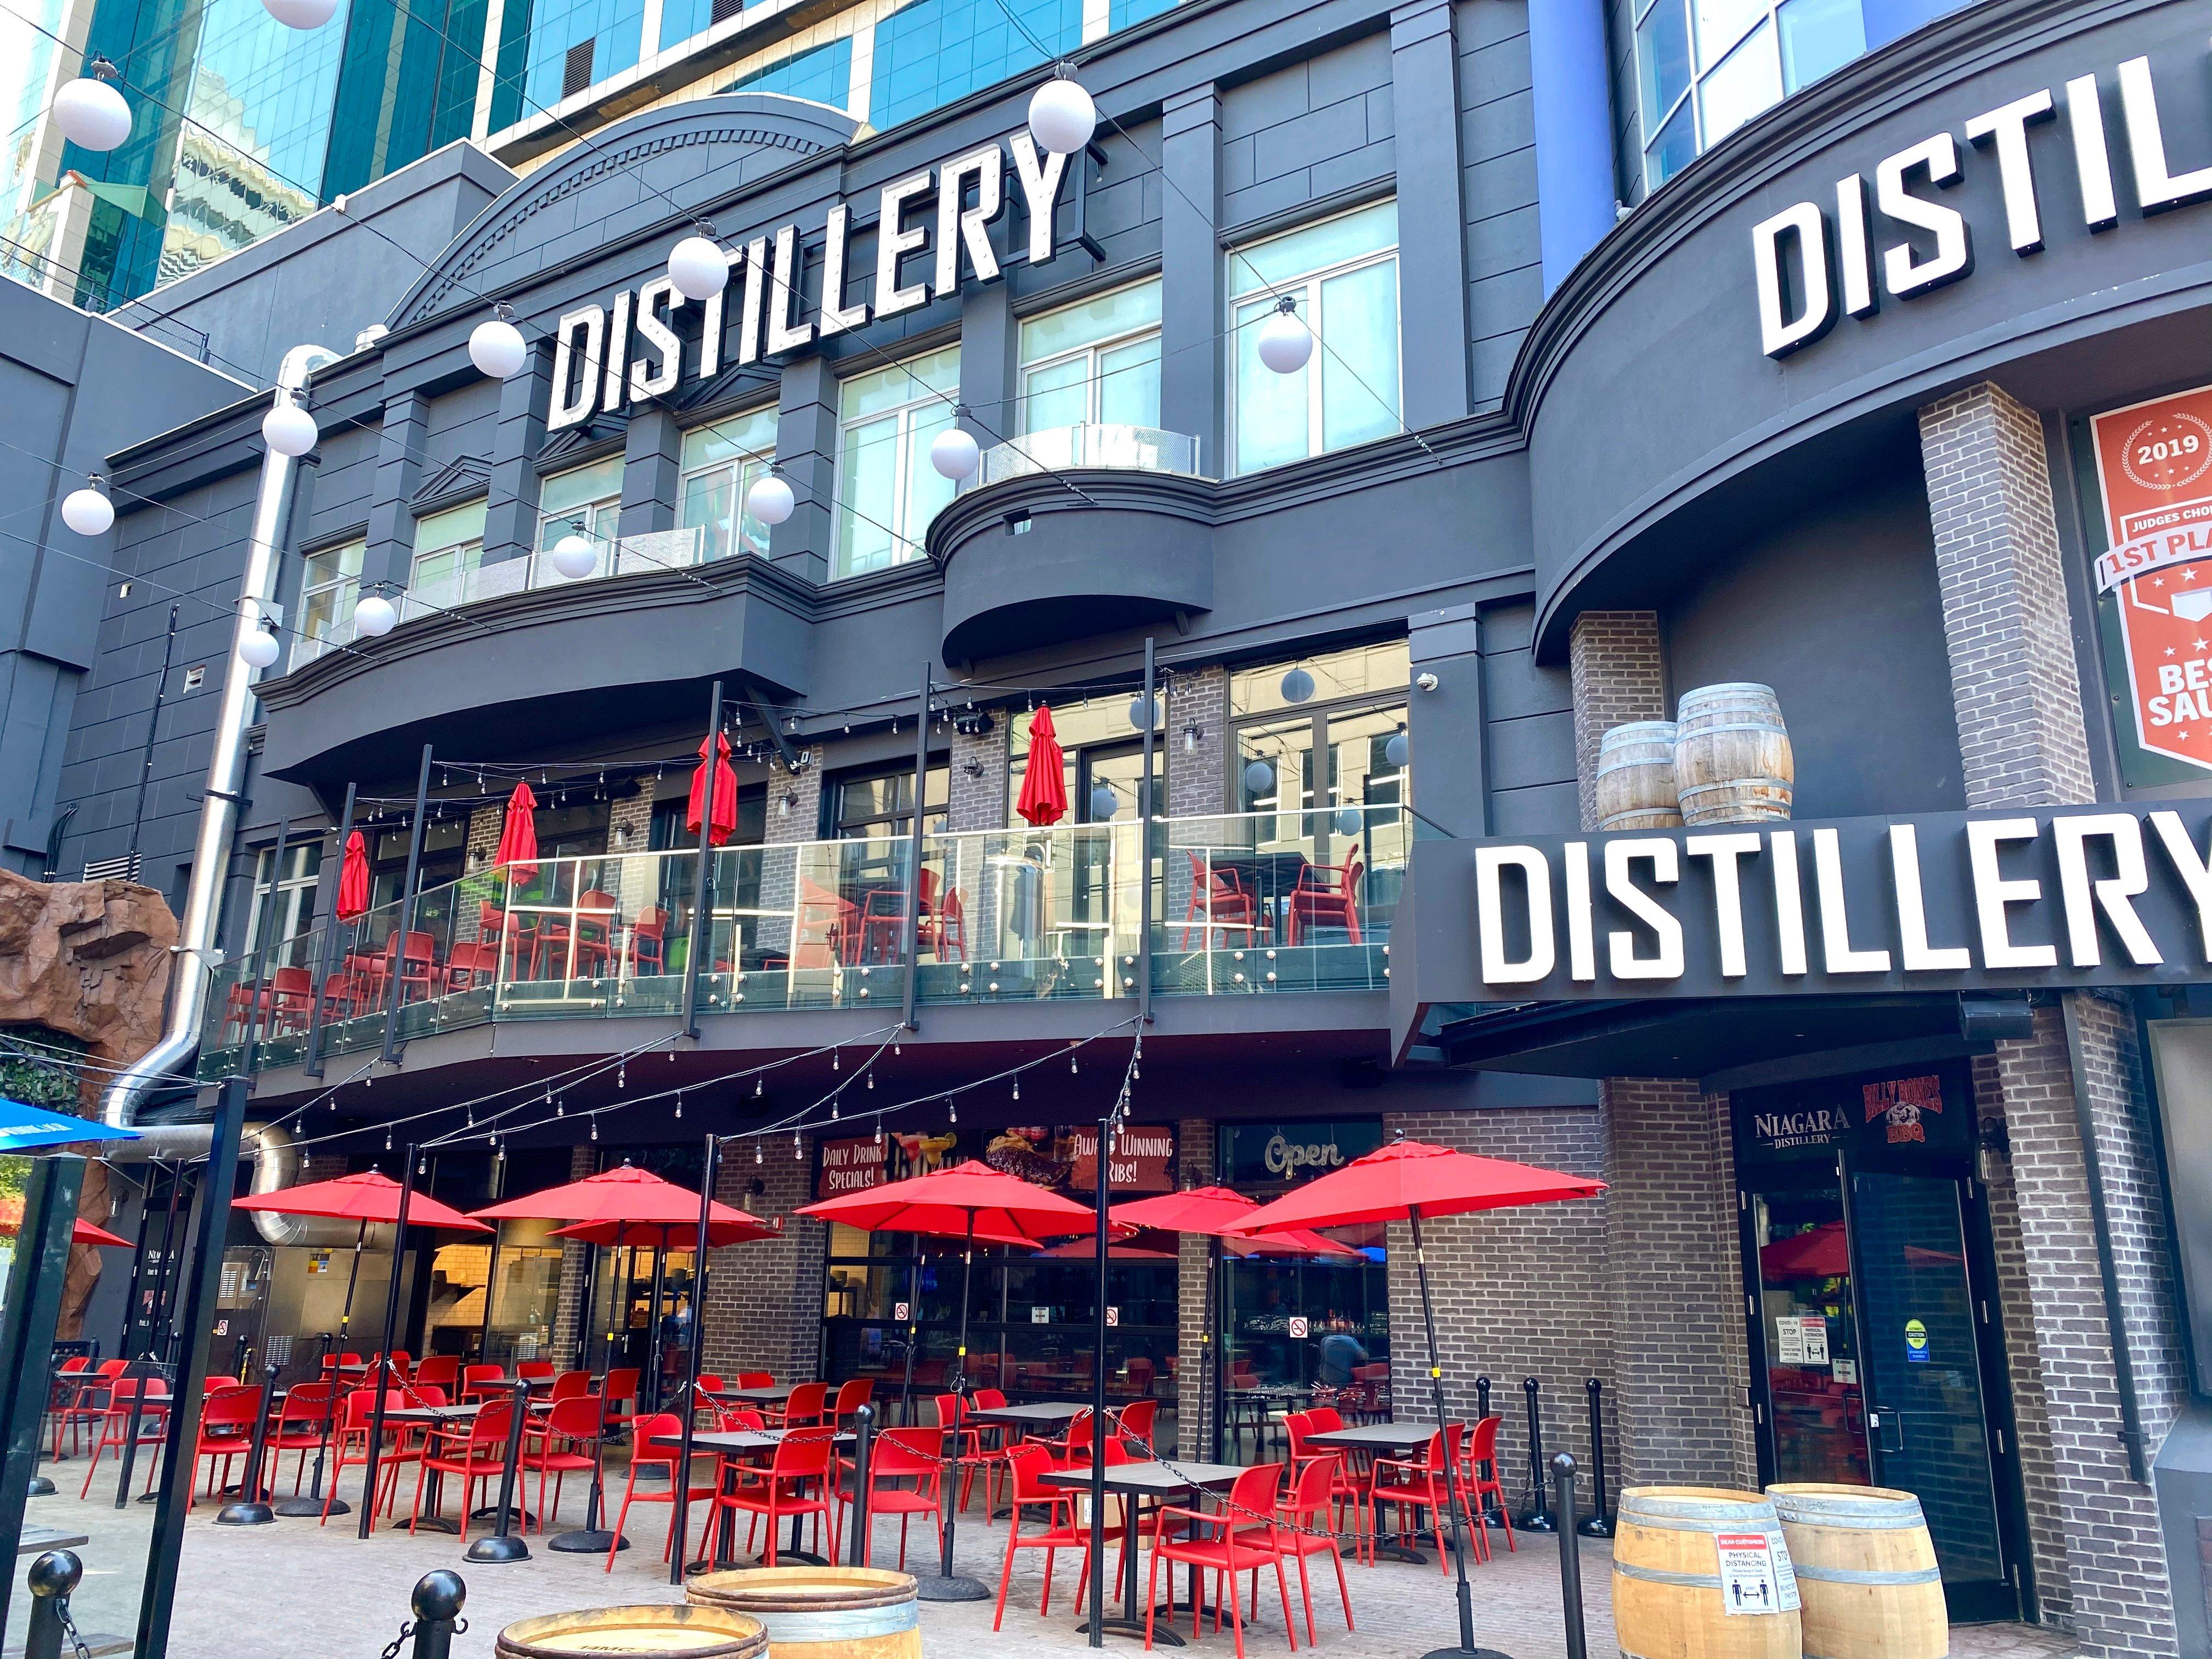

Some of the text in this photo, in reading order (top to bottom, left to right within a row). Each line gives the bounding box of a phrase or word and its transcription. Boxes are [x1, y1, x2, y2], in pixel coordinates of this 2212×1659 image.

[548, 129, 1074, 433] DISTILLERY
[2138, 435, 2199, 465] 2019
[2132, 512, 2180, 533] JUDGES
[2107, 540, 2157, 574] 1ST
[2159, 658, 2212, 695] BE
[1474, 810, 2212, 984] DISTILLERY
[1863, 1075, 1943, 1124] BILLY BONES
[1754, 1104, 1851, 1138] NIAGARA
[1886, 1122, 1925, 1143] BBQ
[823, 1144, 882, 1167] DAILY DRINK
[1121, 1134, 1173, 1157] WINNING
[1265, 1135, 1346, 1180] Open
[1775, 1134, 1831, 1150] DISTILLERY
[829, 1167, 874, 1189] SPECIALS!
